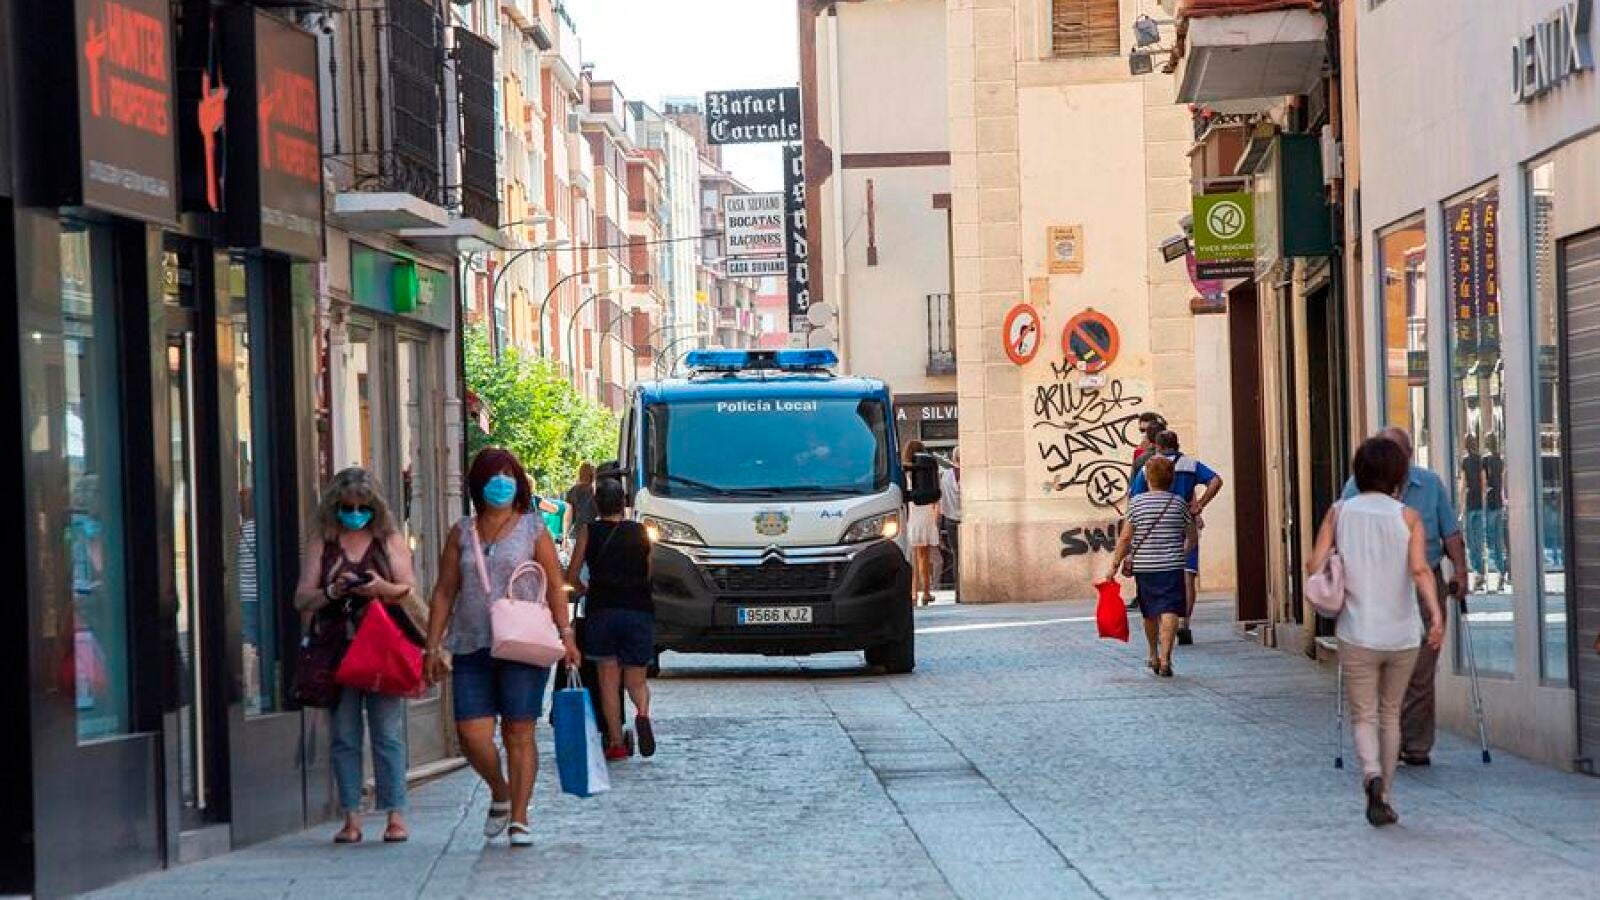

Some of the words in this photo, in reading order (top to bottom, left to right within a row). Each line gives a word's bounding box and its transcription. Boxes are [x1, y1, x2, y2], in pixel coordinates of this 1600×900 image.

[1511, 2, 1592, 104] DENTIX
[709, 92, 785, 118] Rafael
[729, 214, 781, 228] BOCATAS
[730, 232, 781, 247] RACIONES
[776, 399, 817, 412] Local
[747, 609, 779, 622] 9566
[783, 607, 808, 622] KJZ
